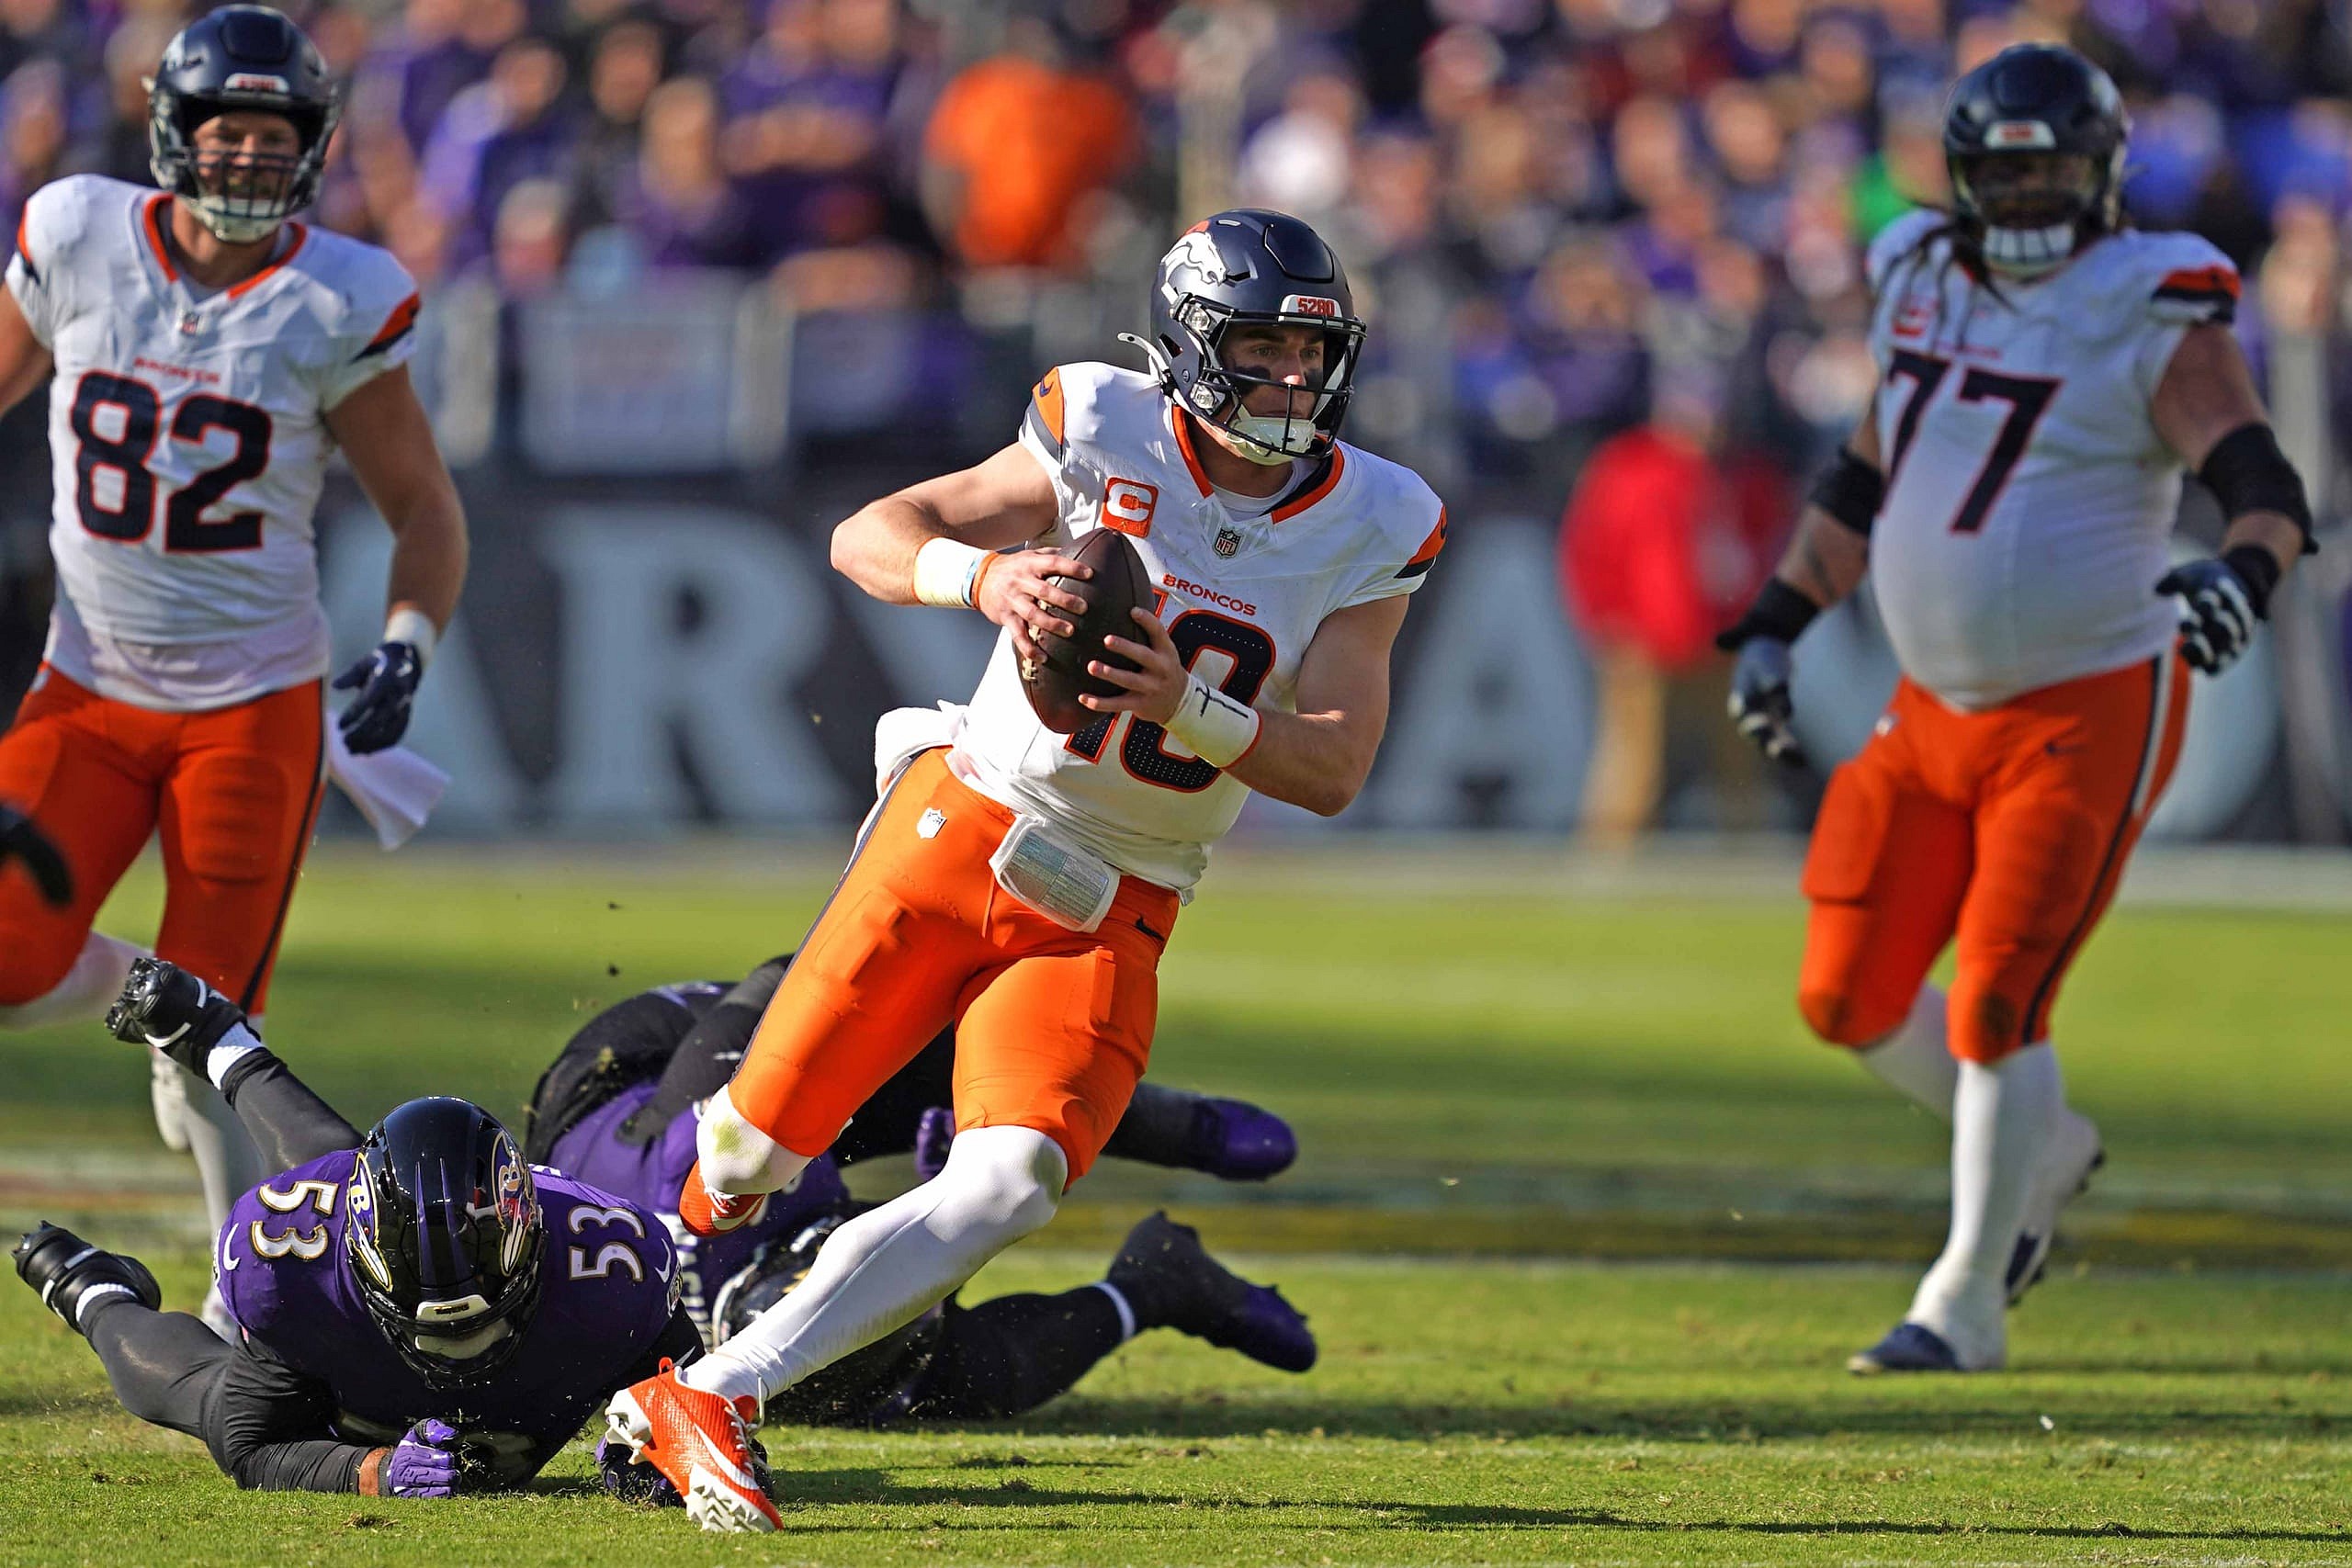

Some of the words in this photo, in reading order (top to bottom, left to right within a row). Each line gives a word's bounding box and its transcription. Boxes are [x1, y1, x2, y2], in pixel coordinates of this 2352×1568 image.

[1297, 297, 1335, 317] 5280
[69, 368, 272, 555] 82
[1882, 345, 2064, 536] 77
[1105, 482, 1153, 523] C
[1216, 537, 1238, 554] NFL
[1162, 573, 1258, 617] BRONCOS
[250, 1179, 340, 1262] 53
[568, 1203, 646, 1282] 53
